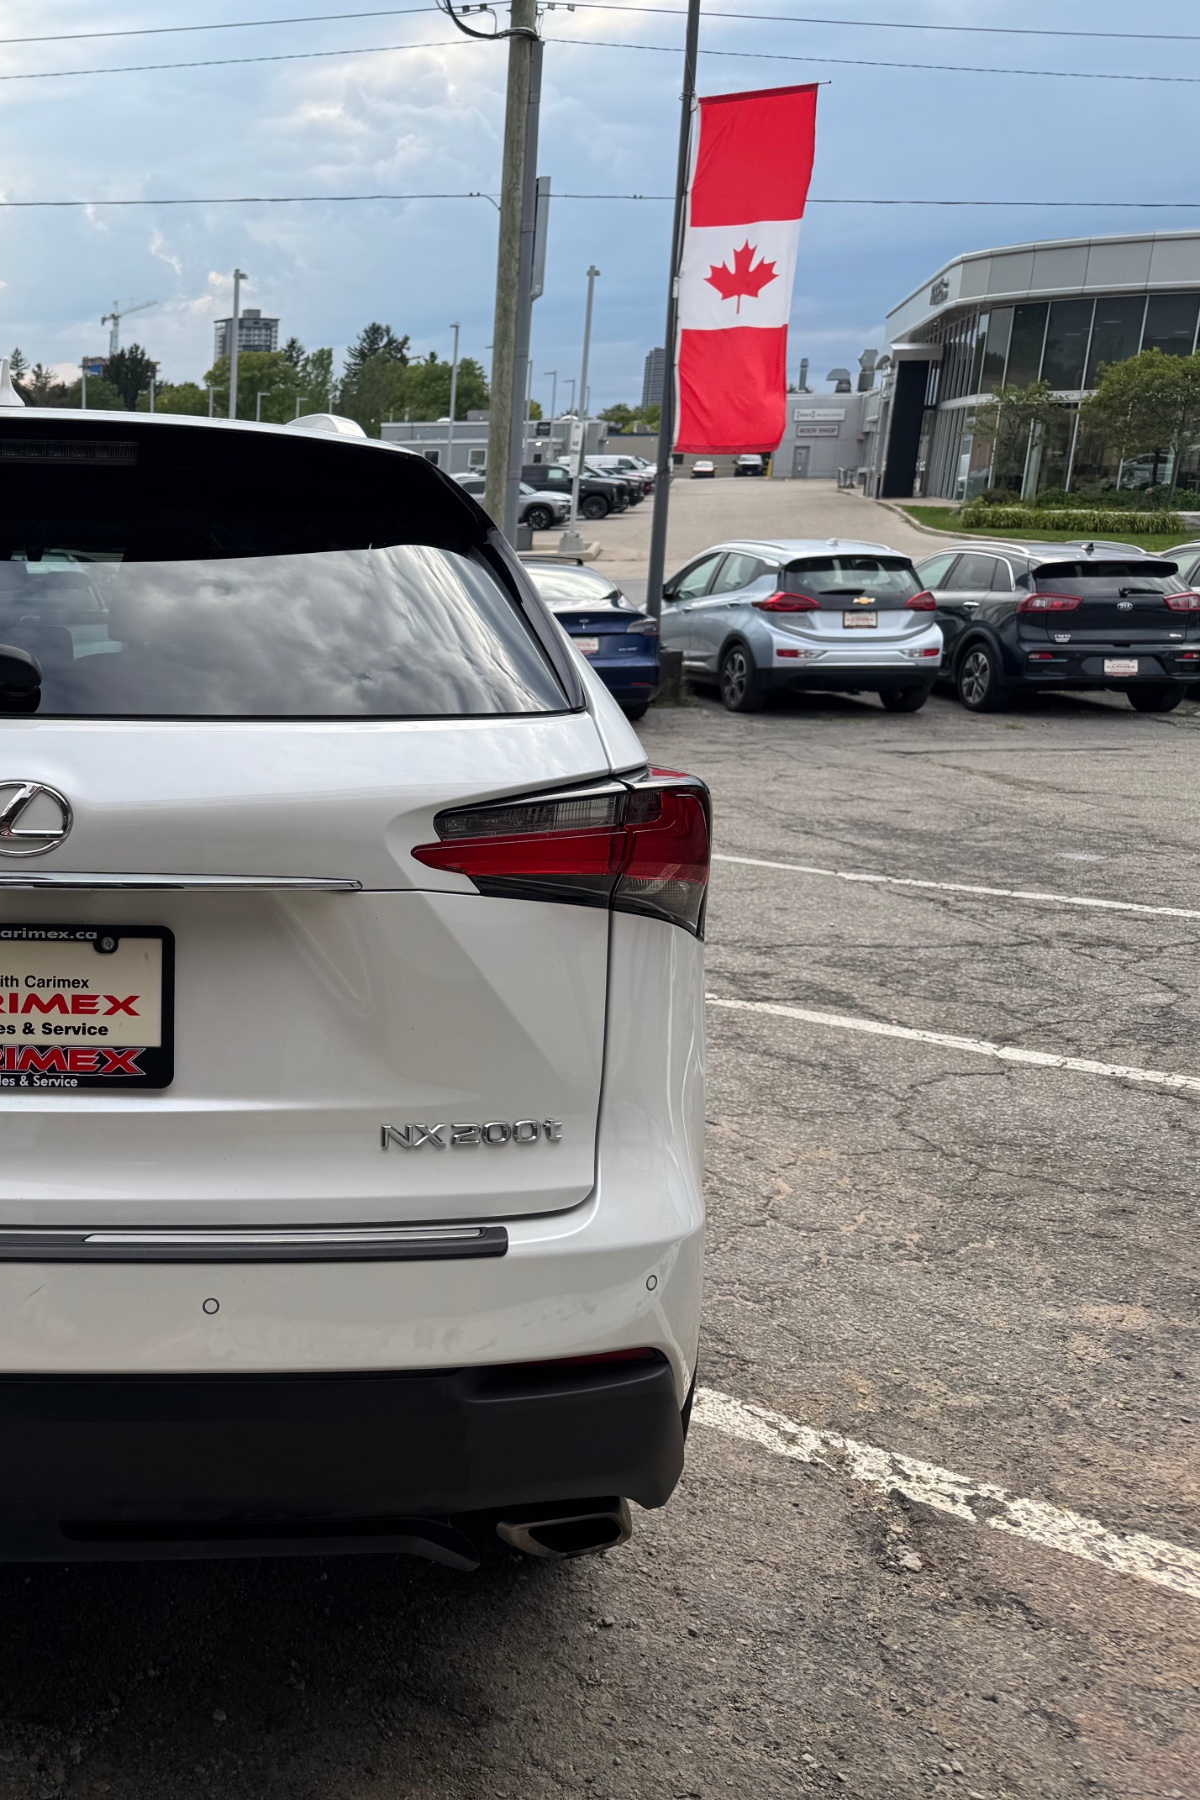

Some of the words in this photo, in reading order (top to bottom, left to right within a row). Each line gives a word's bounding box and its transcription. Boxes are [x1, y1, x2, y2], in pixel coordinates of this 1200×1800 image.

[24, 975, 90, 989] Carimex
[22, 1022, 36, 1035] &
[41, 1022, 109, 1036] Service
[19, 1075, 30, 1087] &
[33, 1075, 79, 1088] Service
